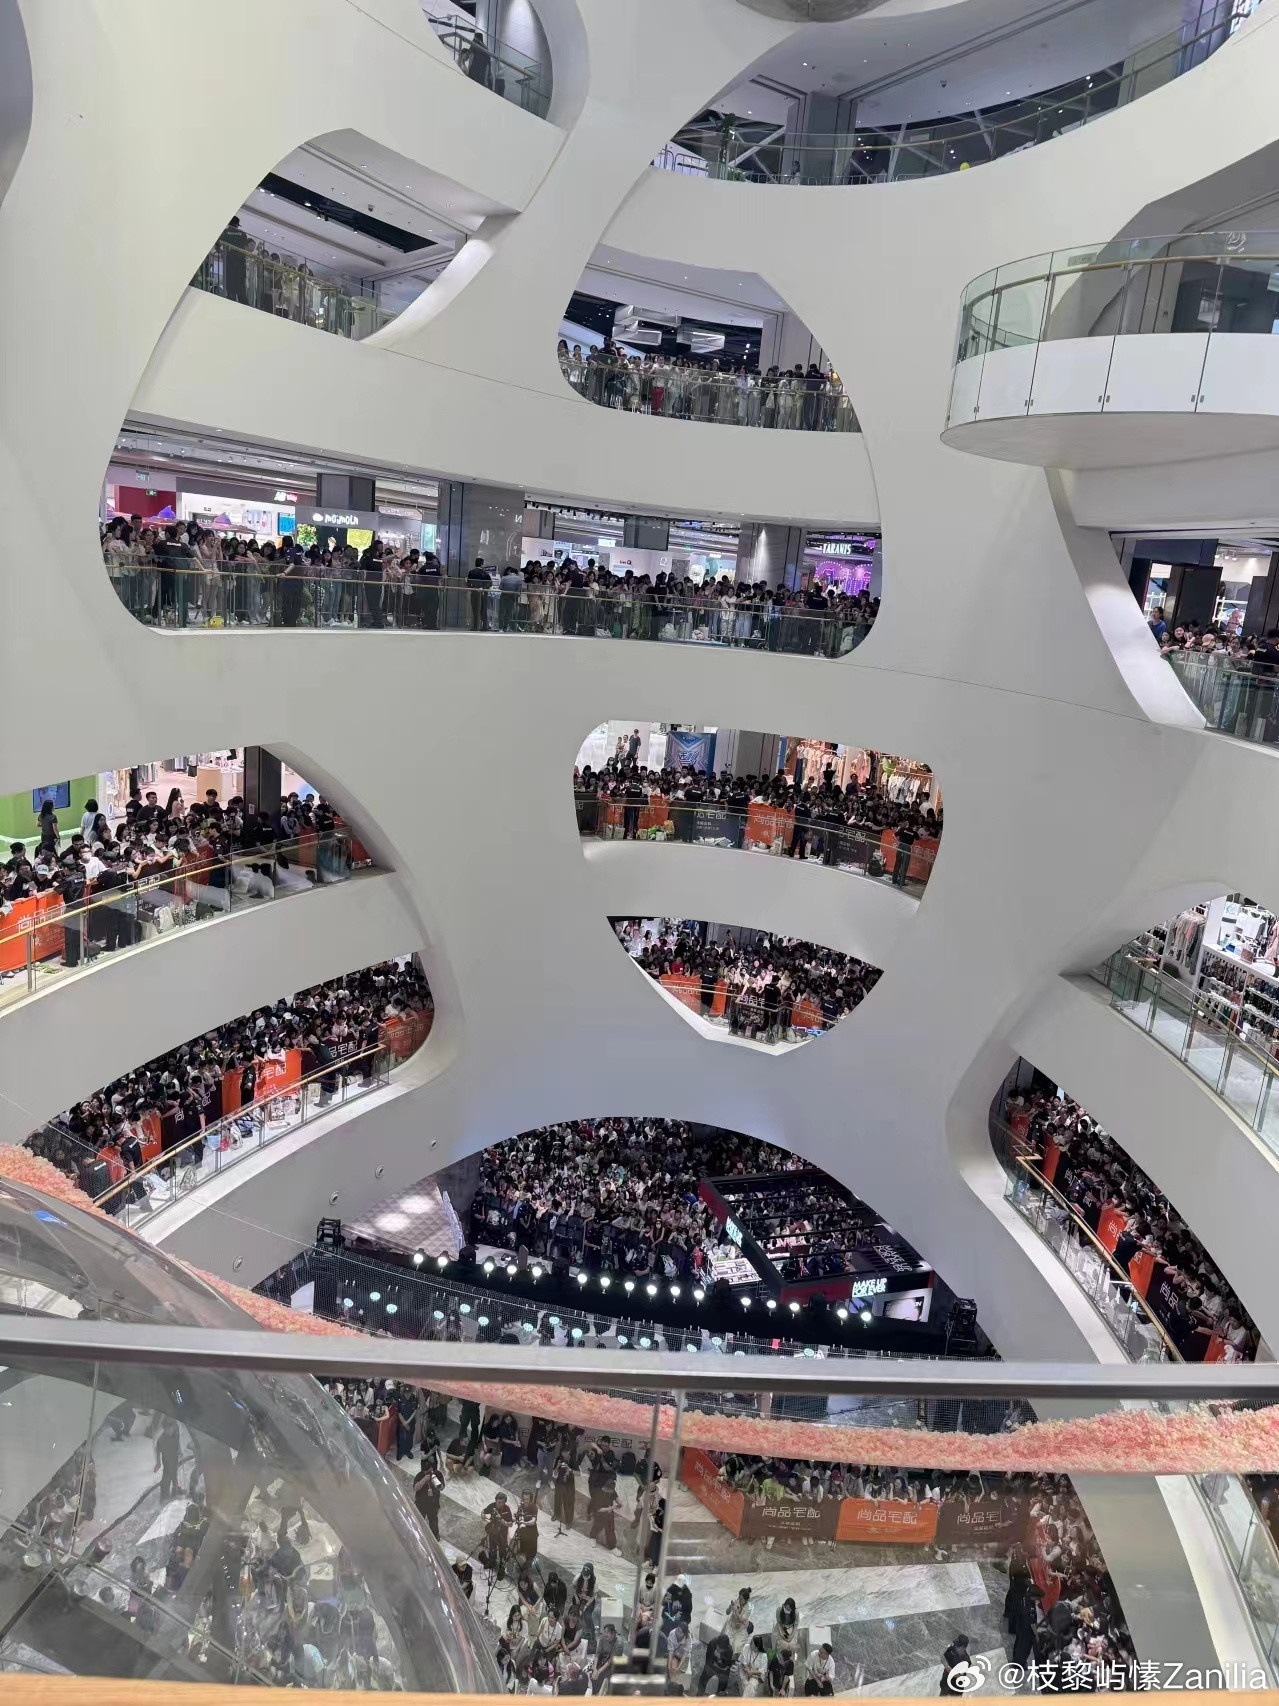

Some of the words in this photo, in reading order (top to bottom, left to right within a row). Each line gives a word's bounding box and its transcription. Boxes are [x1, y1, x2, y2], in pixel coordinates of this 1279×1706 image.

[853, 1279, 876, 1289] MAKE
[876, 1277, 888, 1286] UP
[852, 1286, 868, 1298] FOR
[868, 1284, 886, 1296] EVER
[761, 1505, 822, 1519] 尚品宅配
[857, 1509, 919, 1525] 尚品宅配
